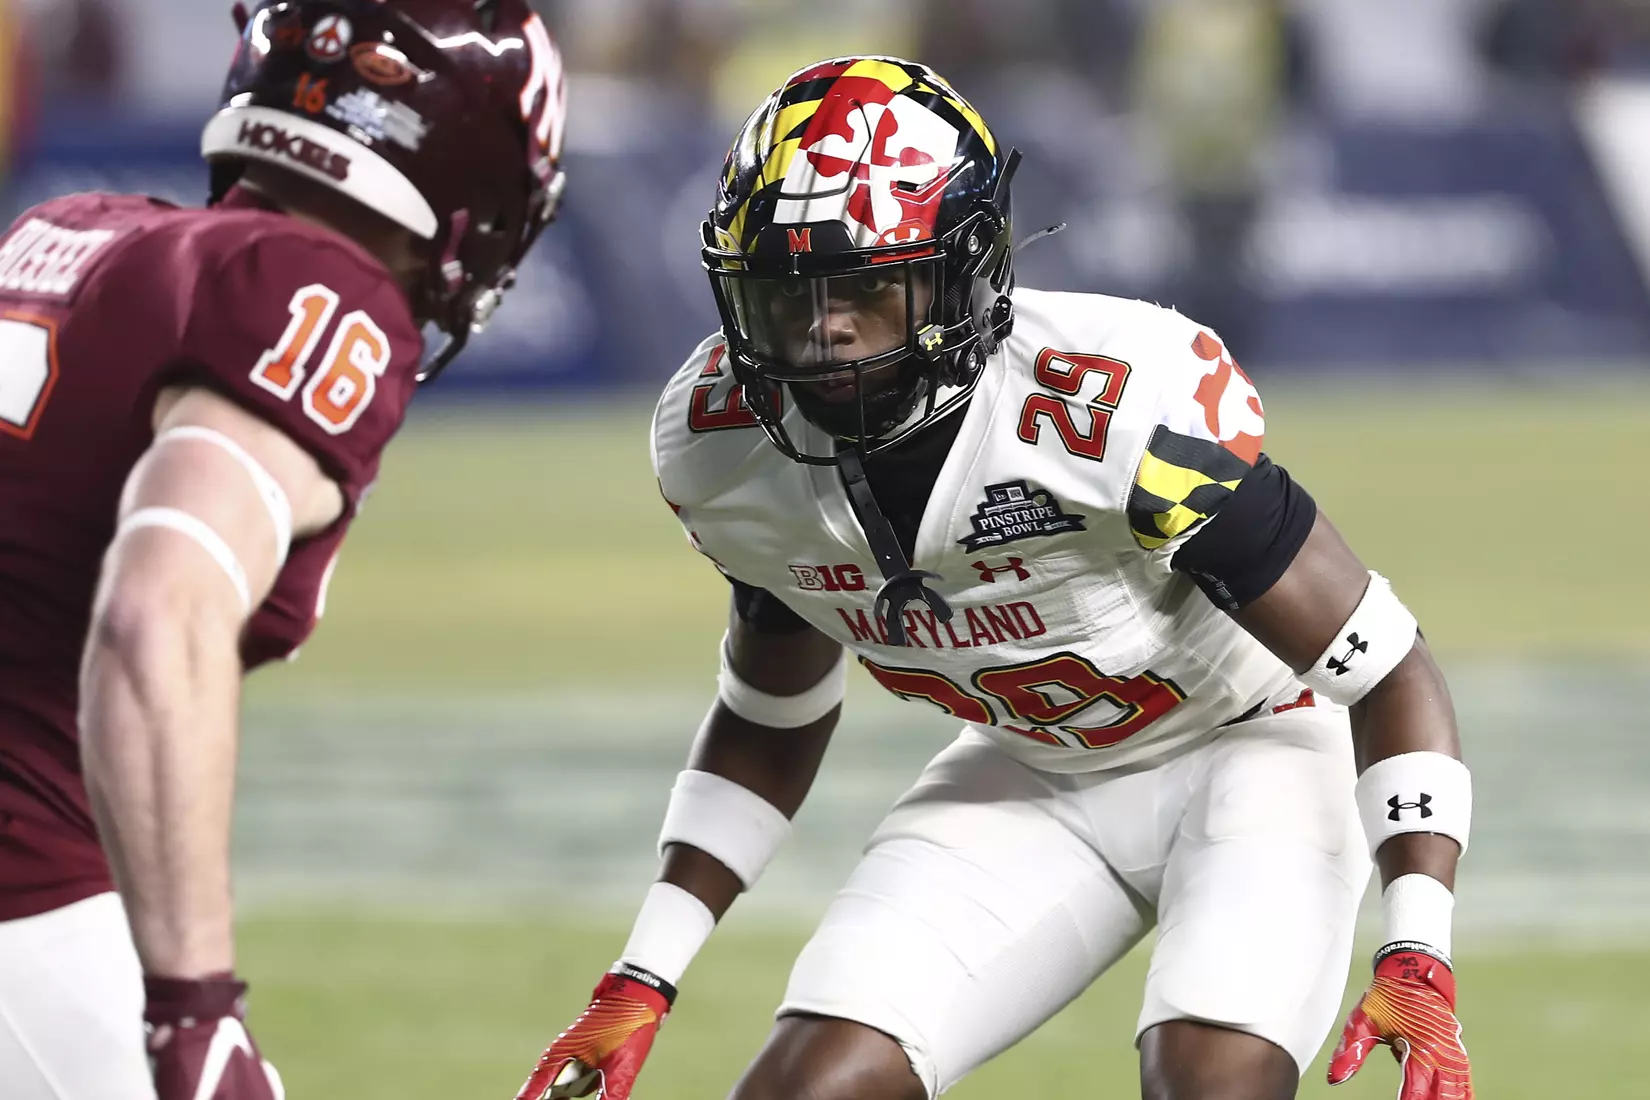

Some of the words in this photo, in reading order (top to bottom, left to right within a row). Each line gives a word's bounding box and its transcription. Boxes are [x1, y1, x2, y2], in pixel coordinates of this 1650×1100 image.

[292, 72, 328, 113] 16
[237, 118, 352, 182] HOKIES
[786, 227, 812, 253] M
[249, 284, 390, 435] 16
[1017, 346, 1132, 462] 29
[979, 506, 1056, 530] PINSTRIPE
[1002, 521, 1042, 537] BOWL
